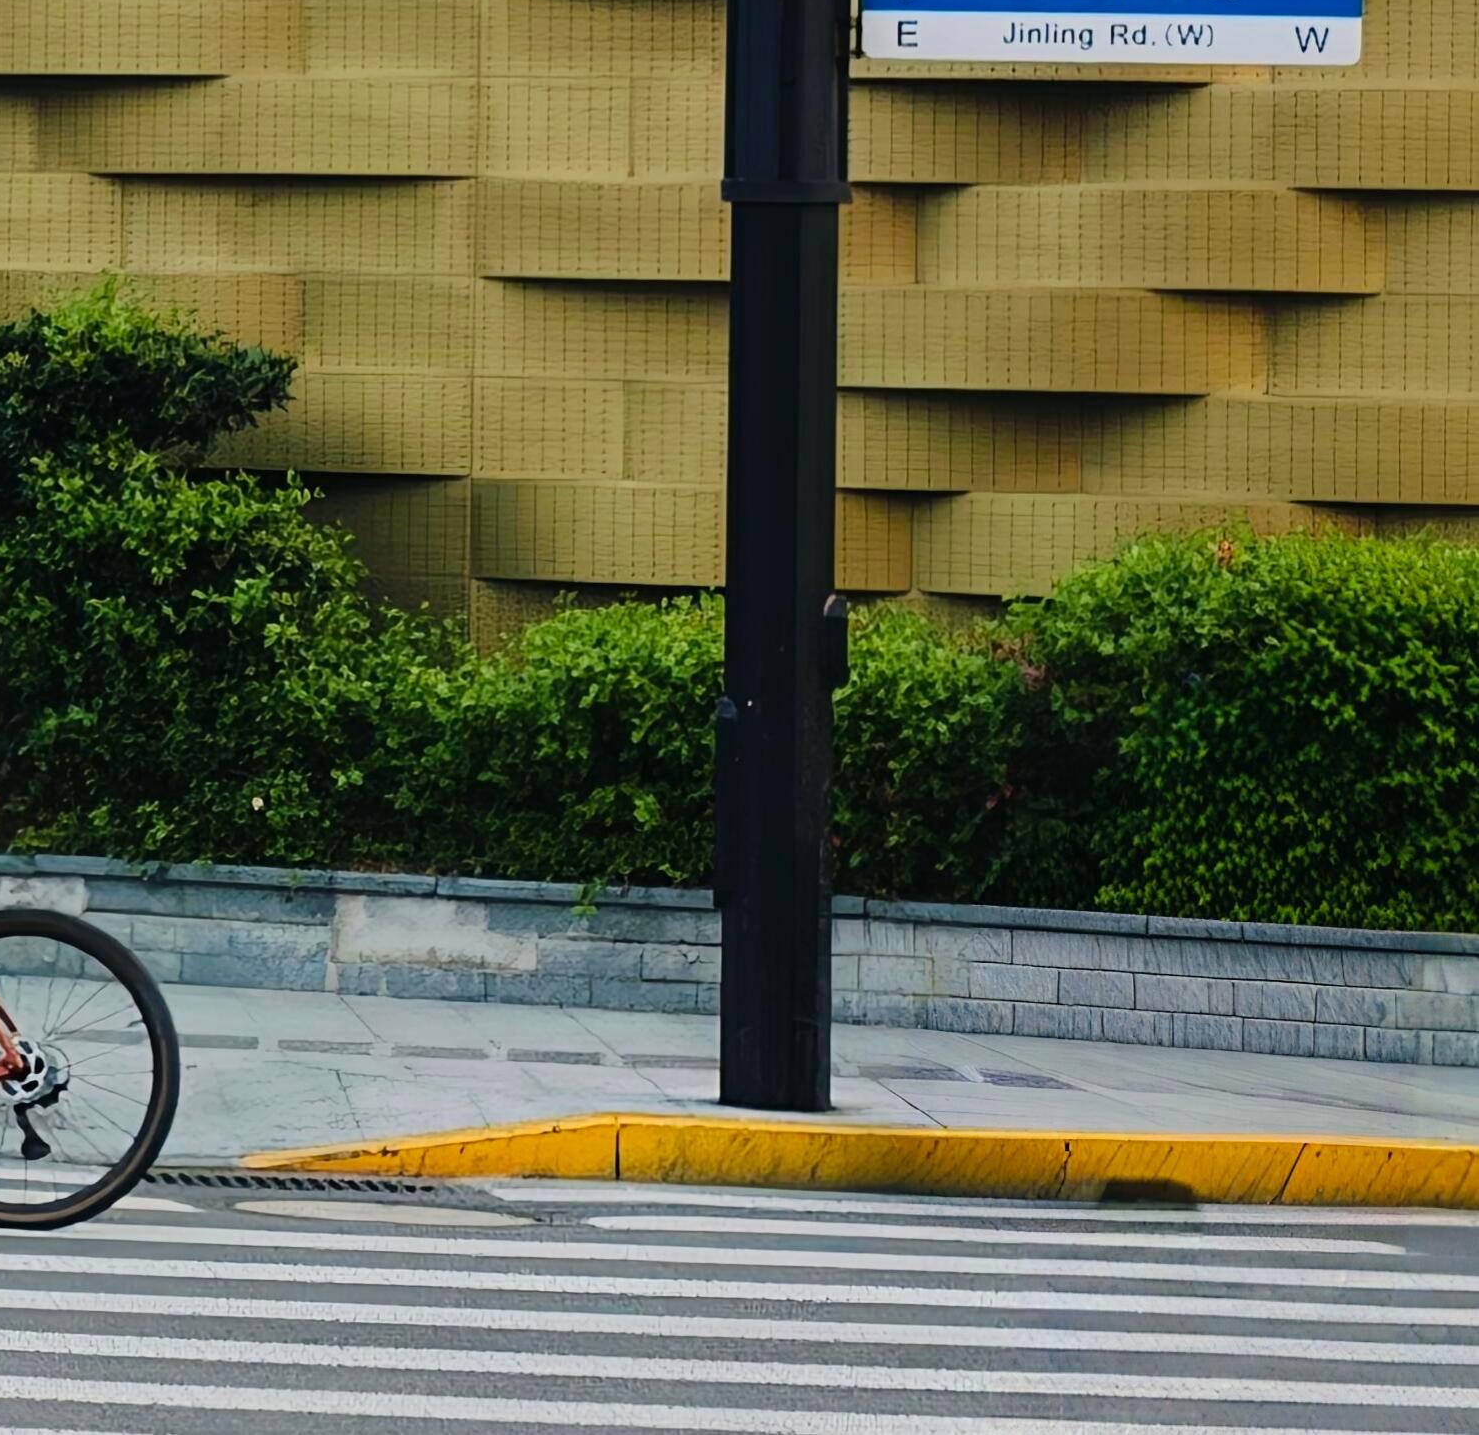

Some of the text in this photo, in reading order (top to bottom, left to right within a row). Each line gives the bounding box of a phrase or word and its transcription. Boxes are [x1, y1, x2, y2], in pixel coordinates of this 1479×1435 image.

[897, 21, 918, 47] E
[1003, 22, 1093, 50] Jinling
[1295, 26, 1329, 53] W
